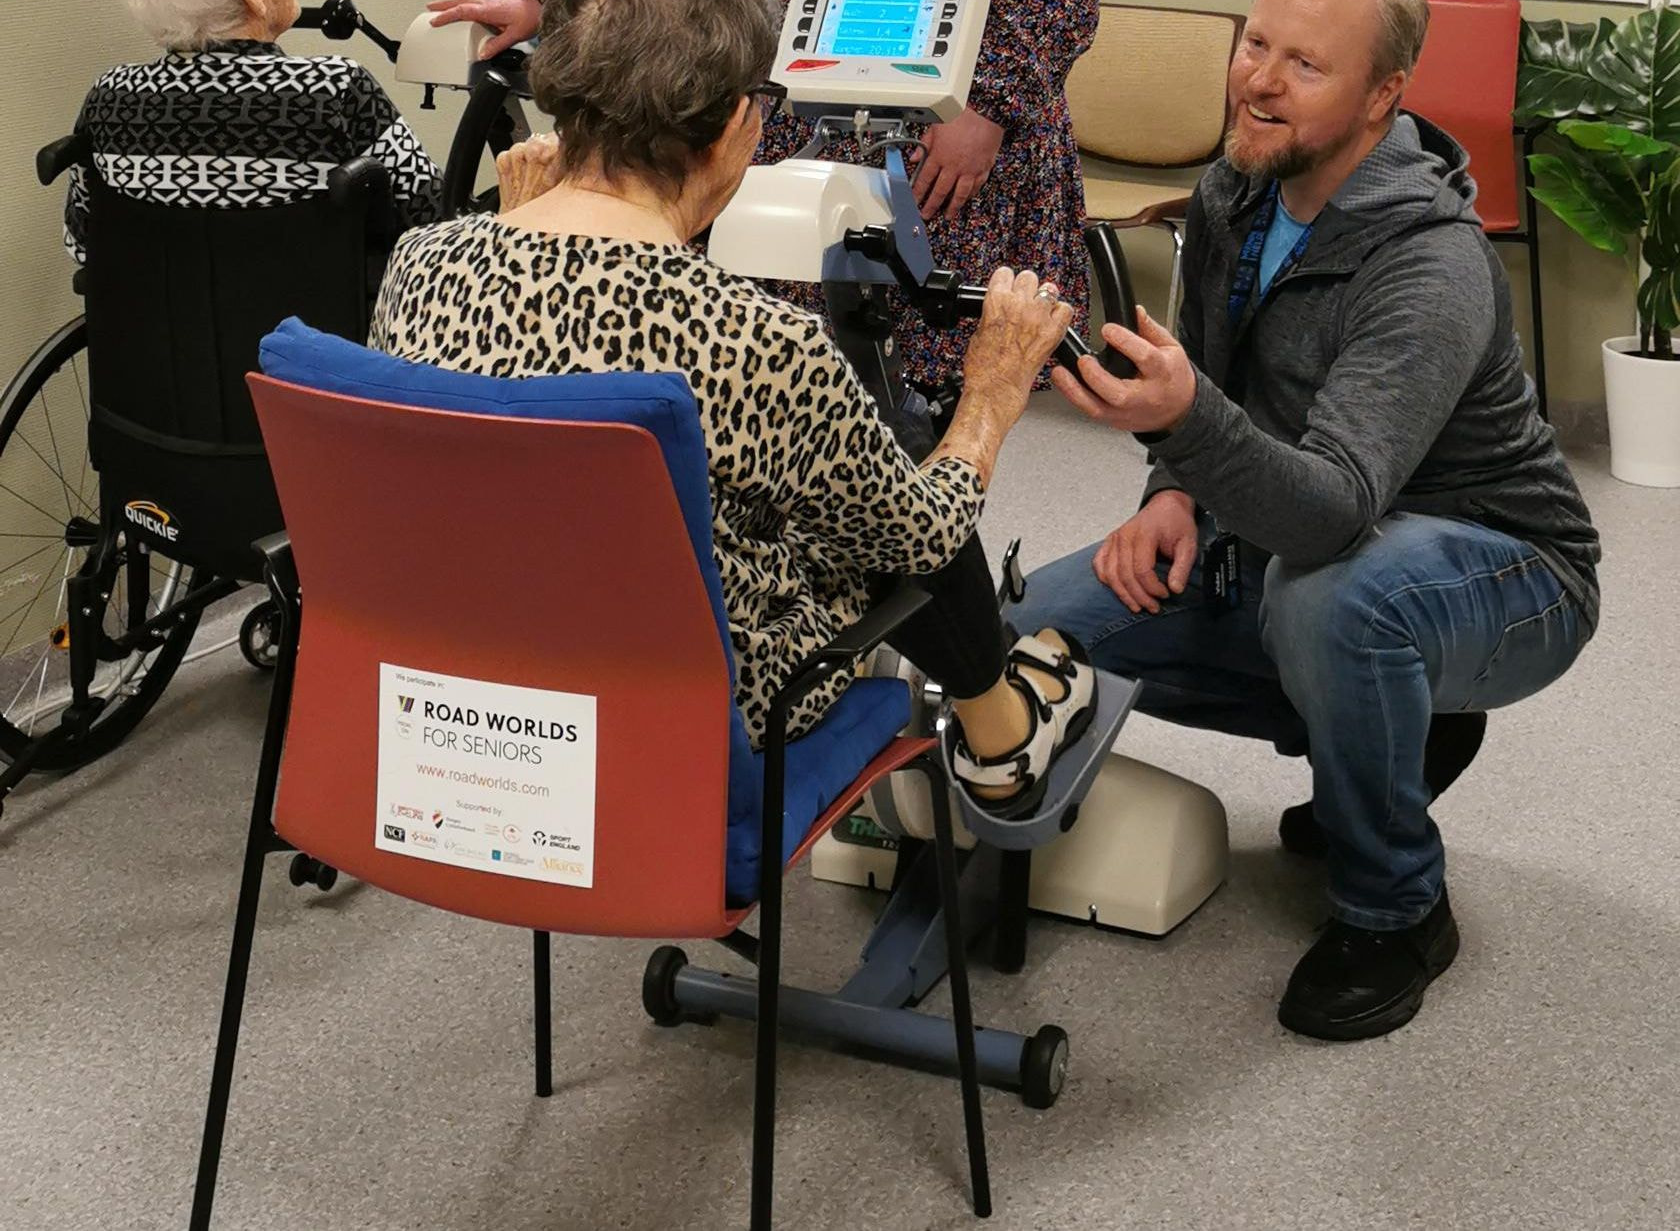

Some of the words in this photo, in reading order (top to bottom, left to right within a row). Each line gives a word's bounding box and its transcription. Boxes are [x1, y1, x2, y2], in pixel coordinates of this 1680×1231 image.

[124, 505, 178, 542] QUICKIE
[424, 700, 479, 727] ROAD
[486, 712, 578, 743] WORLDS
[423, 726, 458, 750] FOR
[463, 734, 542, 765] SENIORS
[416, 763, 550, 798] www.roadworlds.com
[456, 799, 492, 815] Supported
[549, 833, 571, 842] SPORT
[549, 841, 581, 851] ENGLAND
